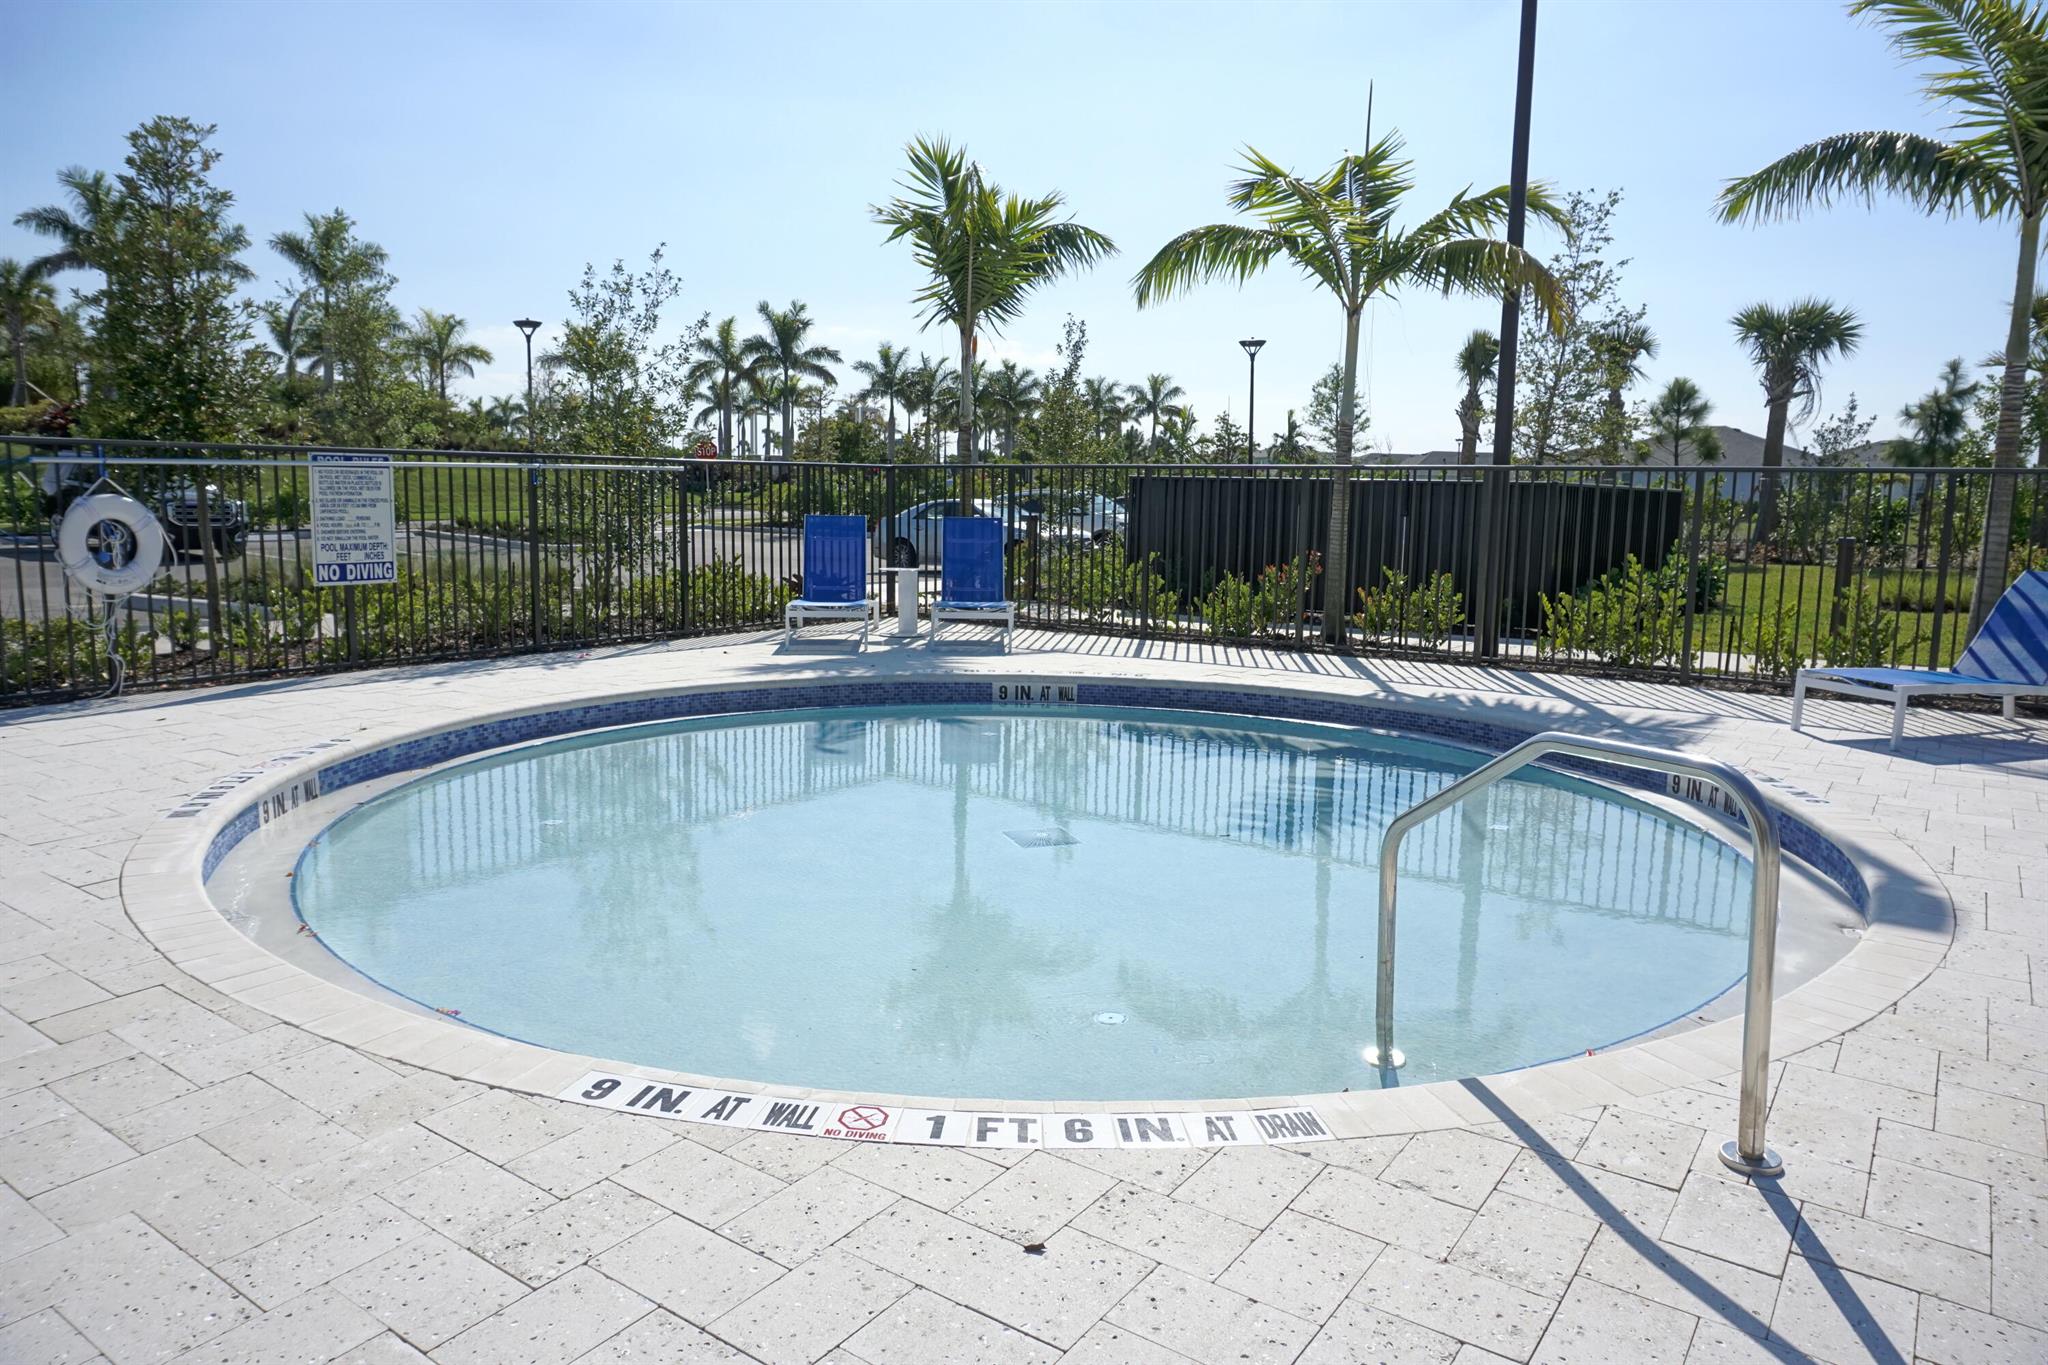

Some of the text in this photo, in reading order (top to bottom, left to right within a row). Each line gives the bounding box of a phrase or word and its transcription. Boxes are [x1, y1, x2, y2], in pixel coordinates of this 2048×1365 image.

[697, 447, 716, 457] STOP
[320, 543, 338, 552] POOL
[339, 542, 368, 552] MAXIMUM
[336, 551, 385, 561] FEET INCHES
[318, 562, 393, 581] NO DIVING
[999, 685, 1075, 702] 9 IN. AT WALL
[1671, 774, 1681, 793] 9
[1686, 777, 1703, 803] IN.
[1707, 785, 1720, 808] AT
[262, 778, 318, 824] 9 IN. AT WALL
[581, 1078, 820, 1130] 9 IN. AT WALL
[823, 1128, 887, 1141] NO DIVING
[926, 1111, 1328, 1144] 1 FT. 6 IN. AT DRAIN
